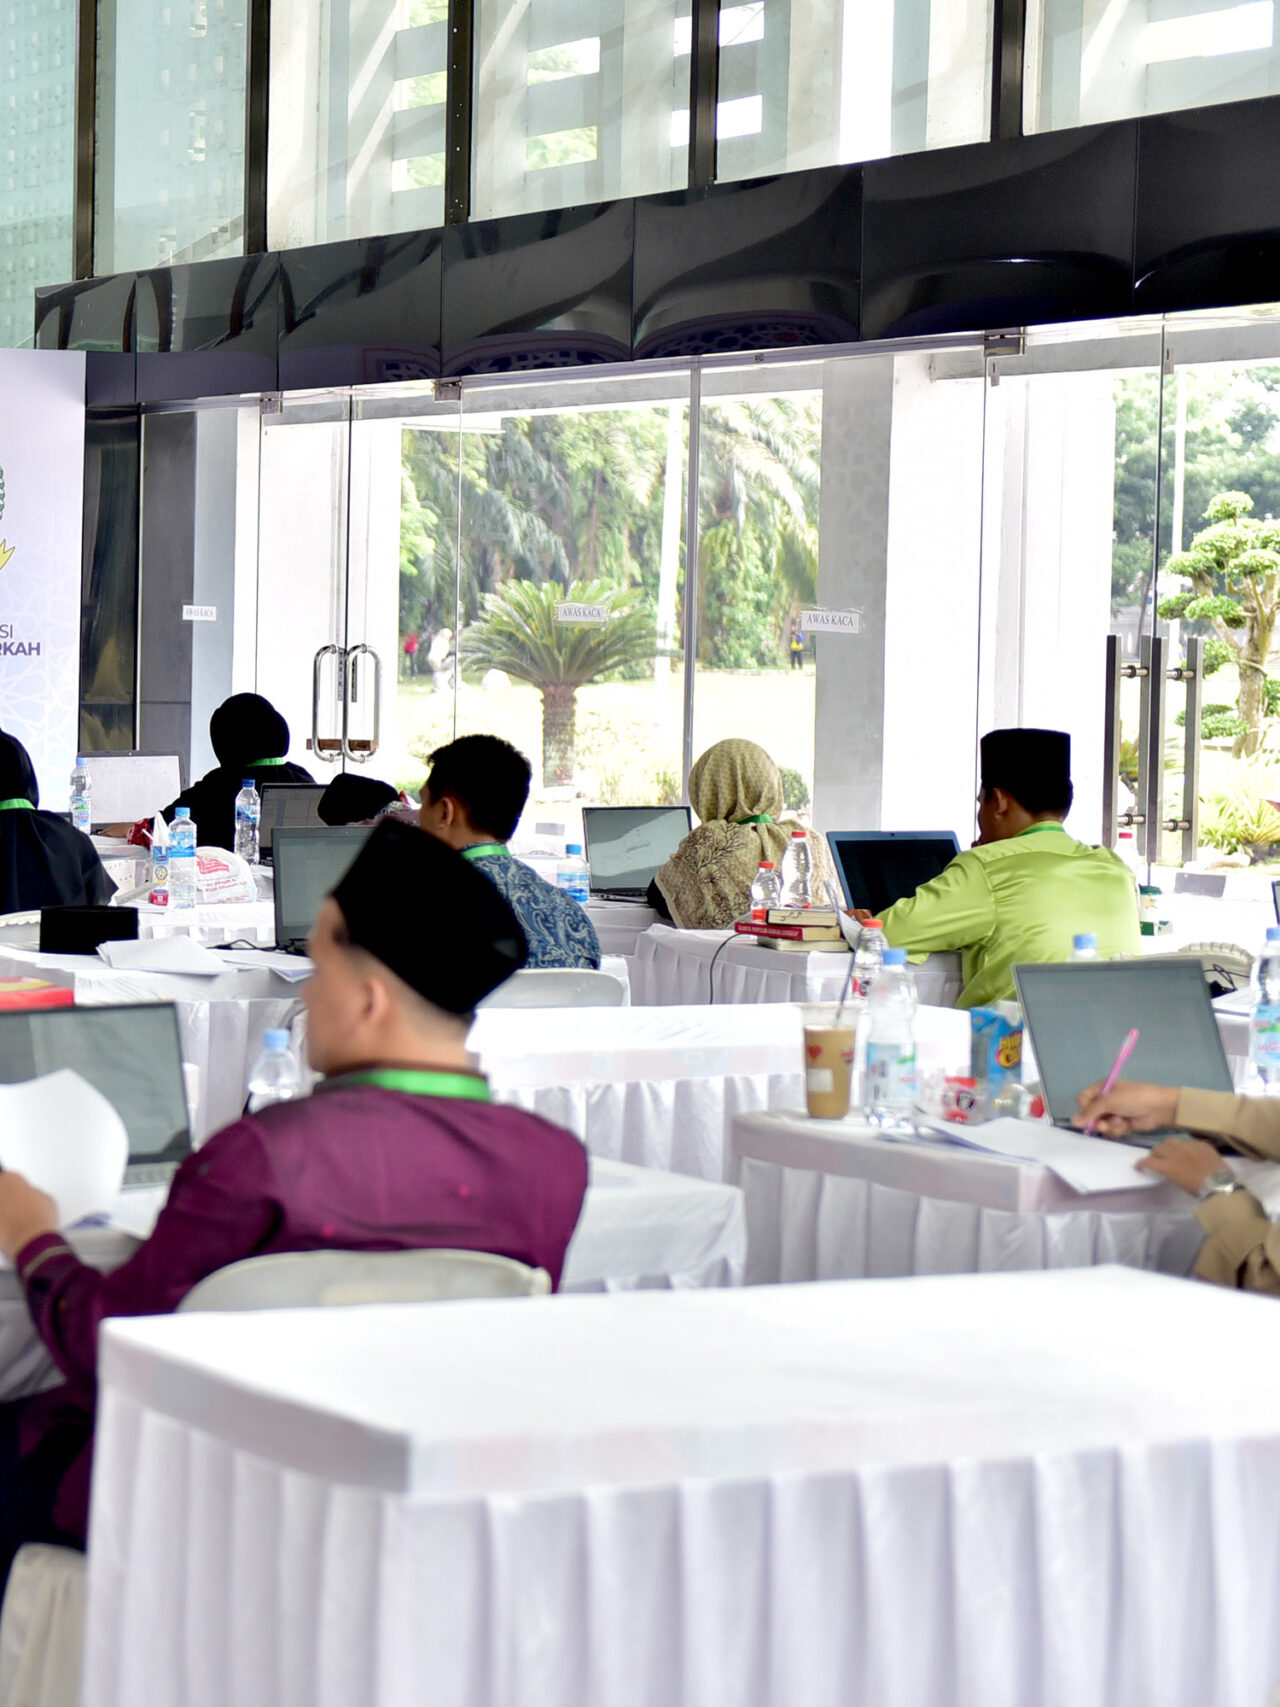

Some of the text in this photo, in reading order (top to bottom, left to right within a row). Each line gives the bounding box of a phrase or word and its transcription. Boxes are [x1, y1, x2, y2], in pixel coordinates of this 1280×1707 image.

[562, 607, 601, 618] AWAS KACA
[806, 613, 854, 627] AWAS KACA
